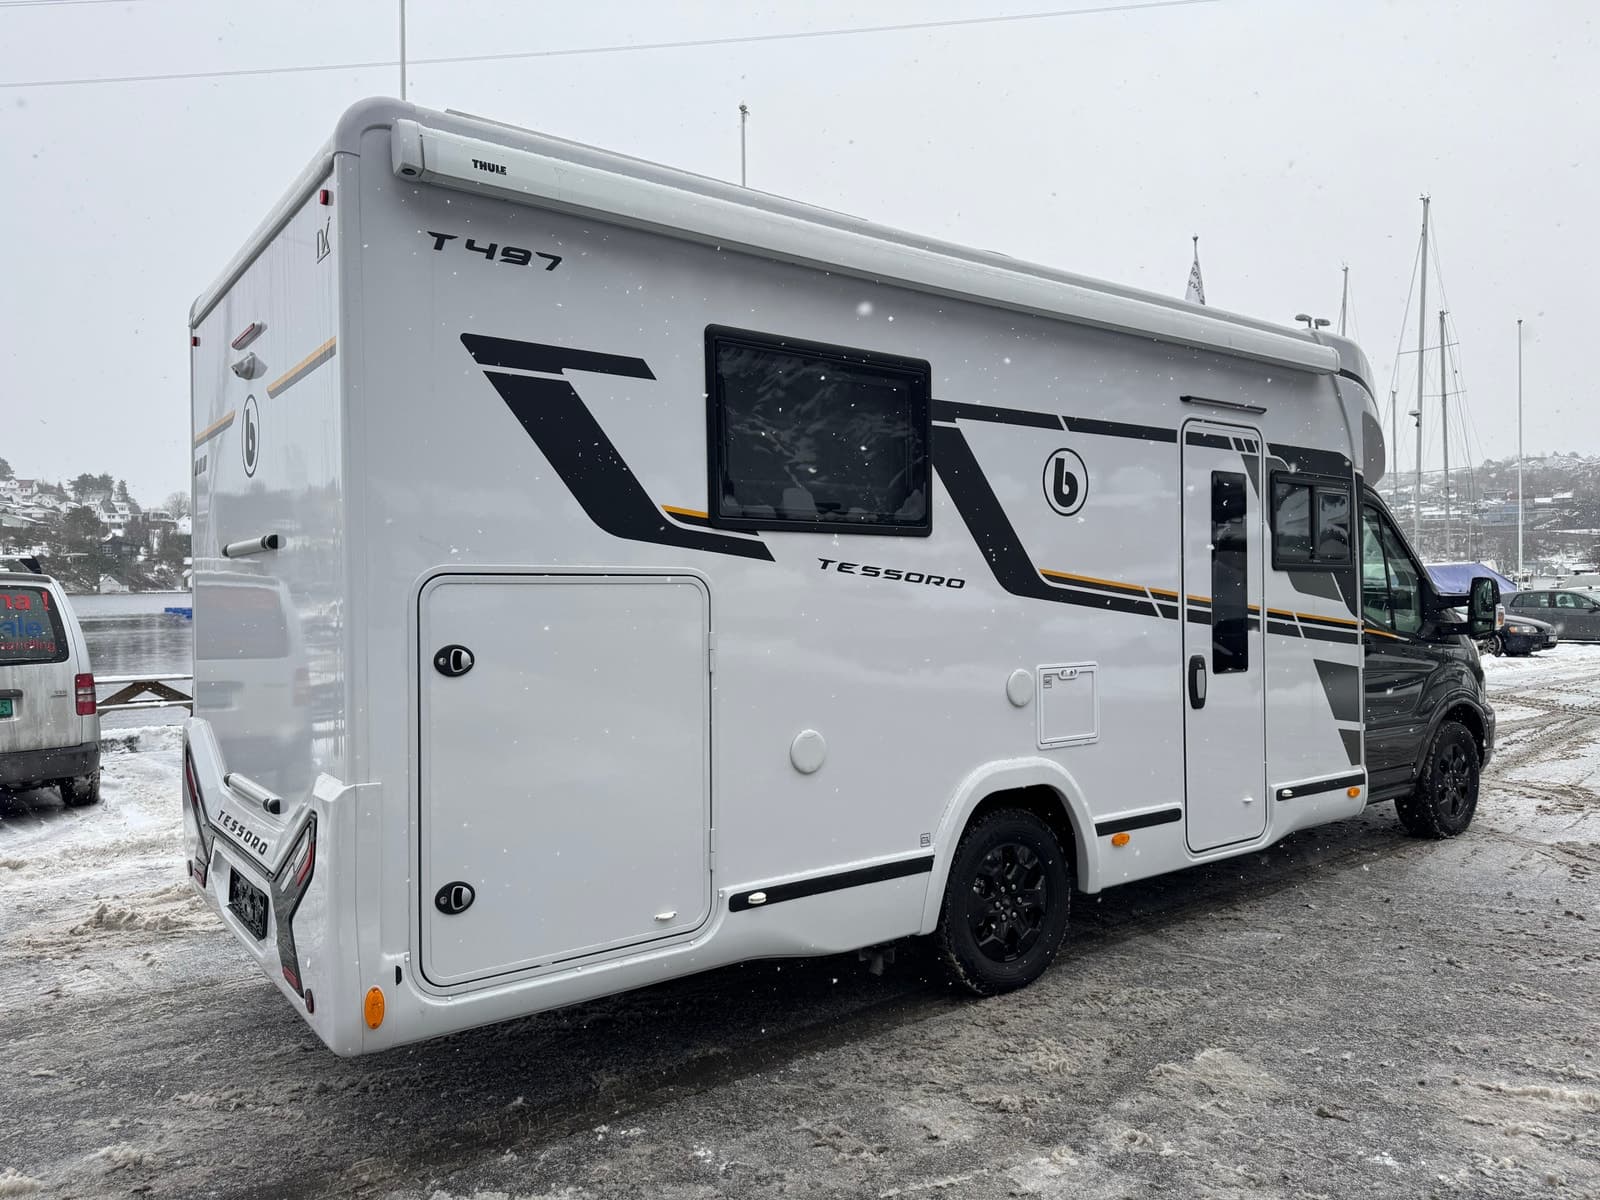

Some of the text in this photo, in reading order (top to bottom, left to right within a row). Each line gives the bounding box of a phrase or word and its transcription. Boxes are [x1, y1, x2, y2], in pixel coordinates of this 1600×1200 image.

[472, 159, 507, 176] THULE
[427, 230, 563, 272] T 497
[817, 557, 966, 590] TESSORO
[217, 809, 268, 856] TESSORO
